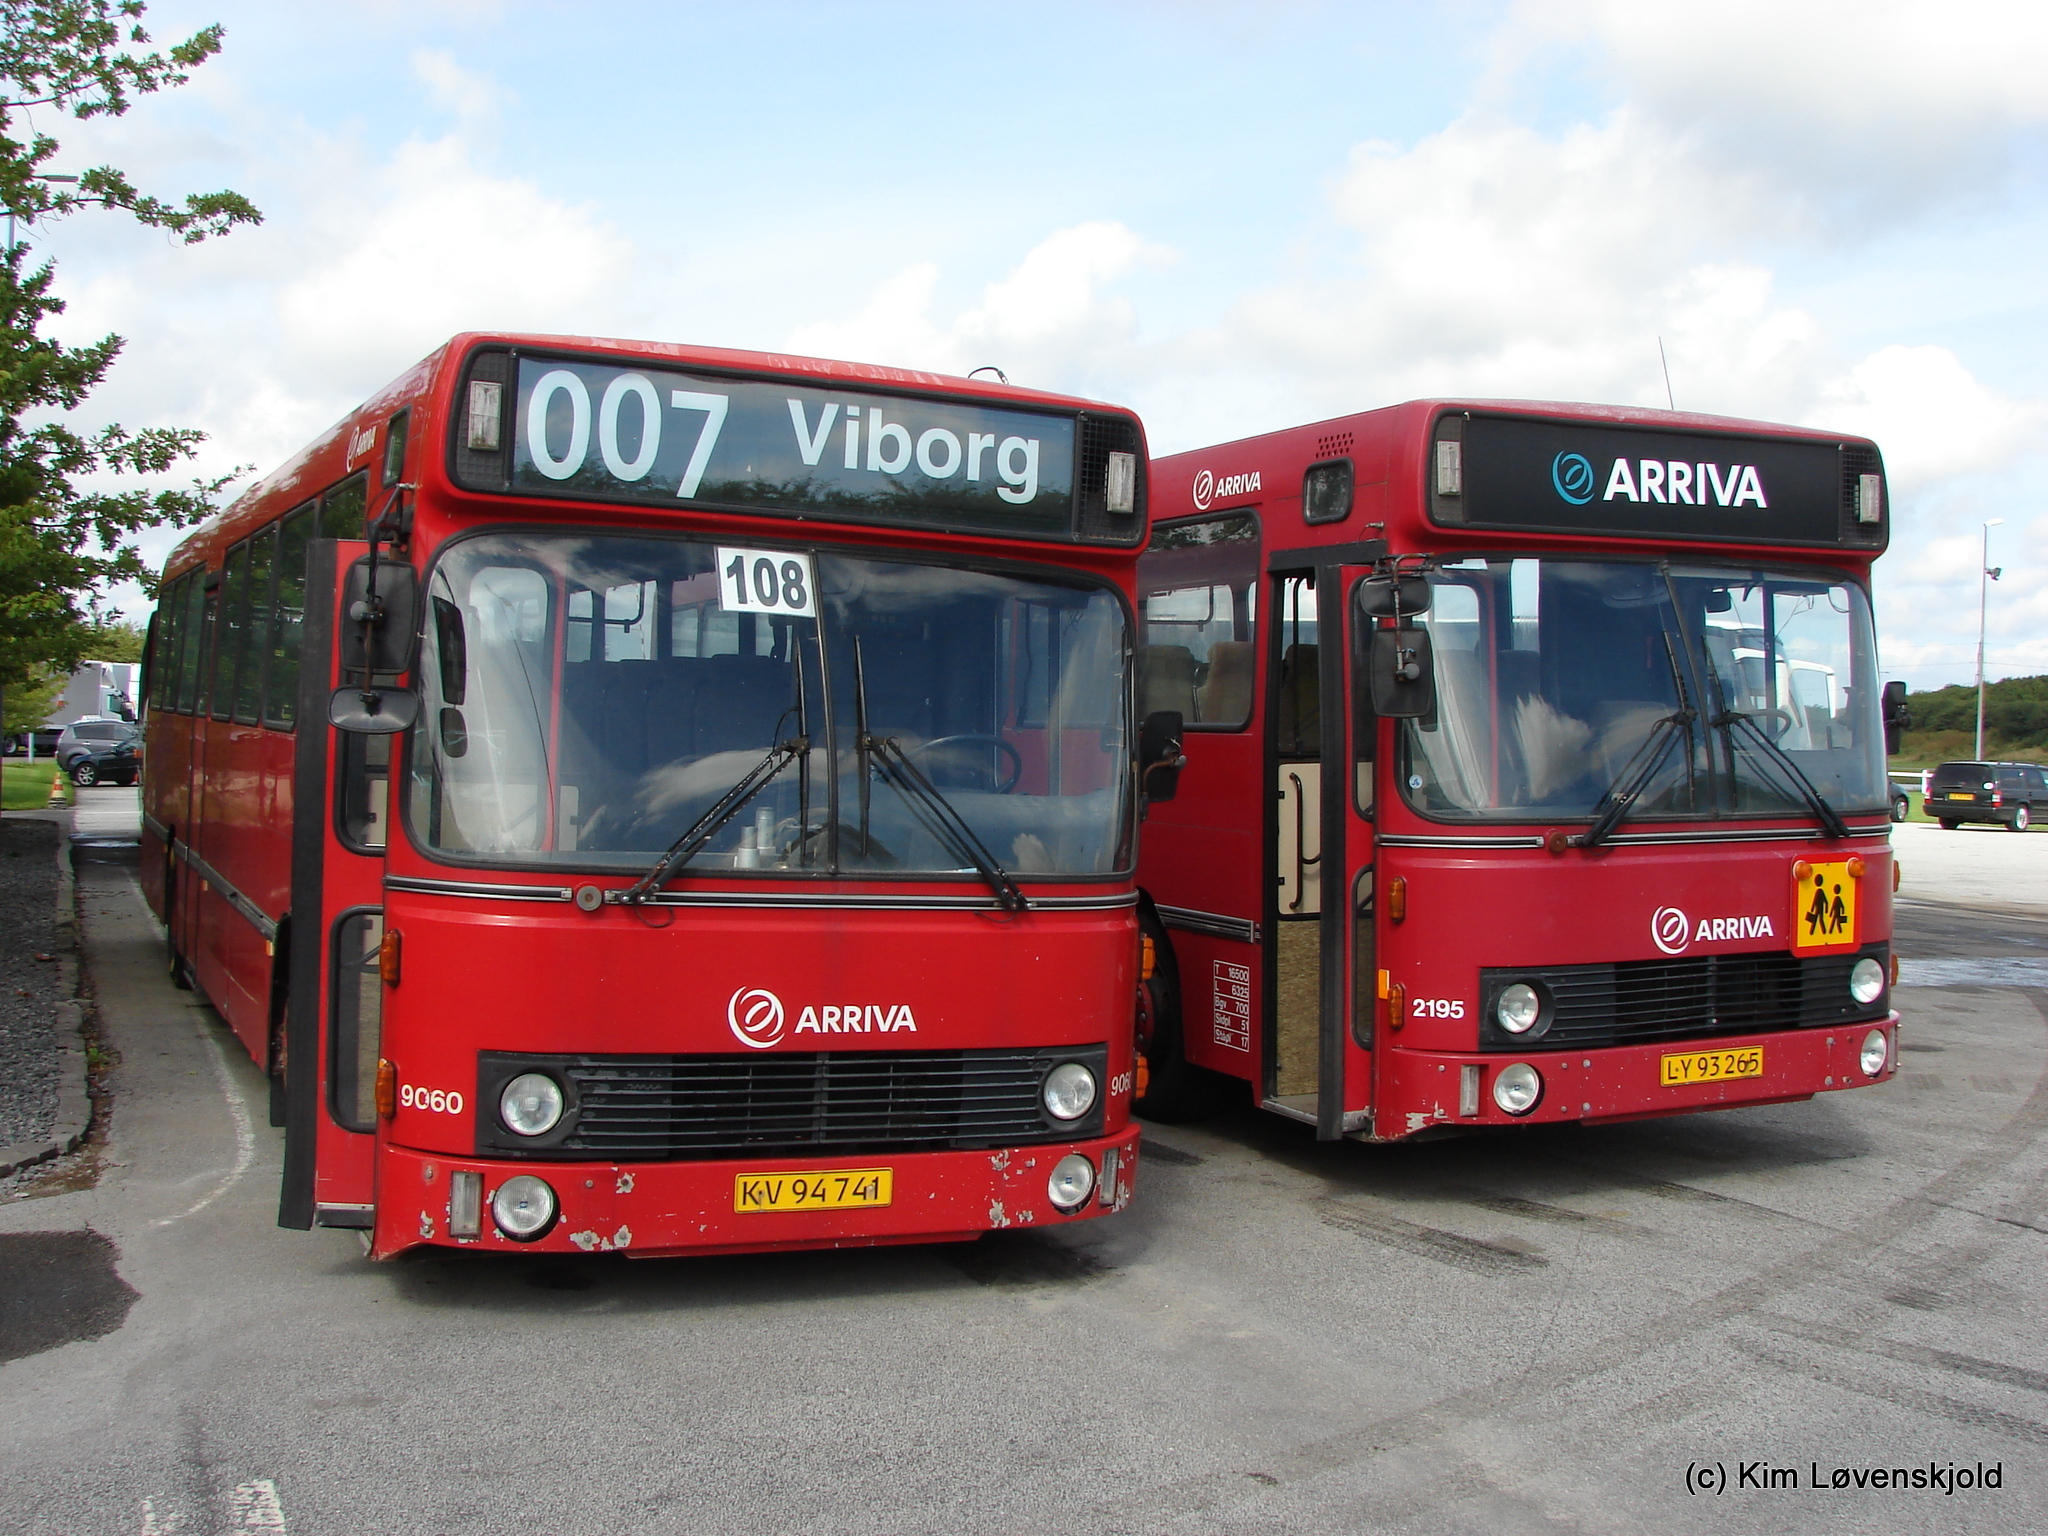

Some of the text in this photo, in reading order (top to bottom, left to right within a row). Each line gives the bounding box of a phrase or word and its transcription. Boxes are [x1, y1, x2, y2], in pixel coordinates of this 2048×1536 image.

[527, 370, 1040, 505] 007 Viborg
[1215, 471, 1262, 498] ARRIVA
[1602, 457, 1768, 509] ARRIVA
[726, 555, 808, 609] 108
[1694, 915, 1774, 942] ARRIVA
[1228, 967, 1249, 982] 16500
[1231, 984, 1249, 998] 6325
[794, 1005, 918, 1034] ARRIVA
[1235, 1002, 1249, 1015] 700
[1412, 998, 1465, 1020] 2195
[1667, 1058, 1692, 1080] LY
[400, 1084, 464, 1115] 9060
[742, 1180, 783, 1206] KV
